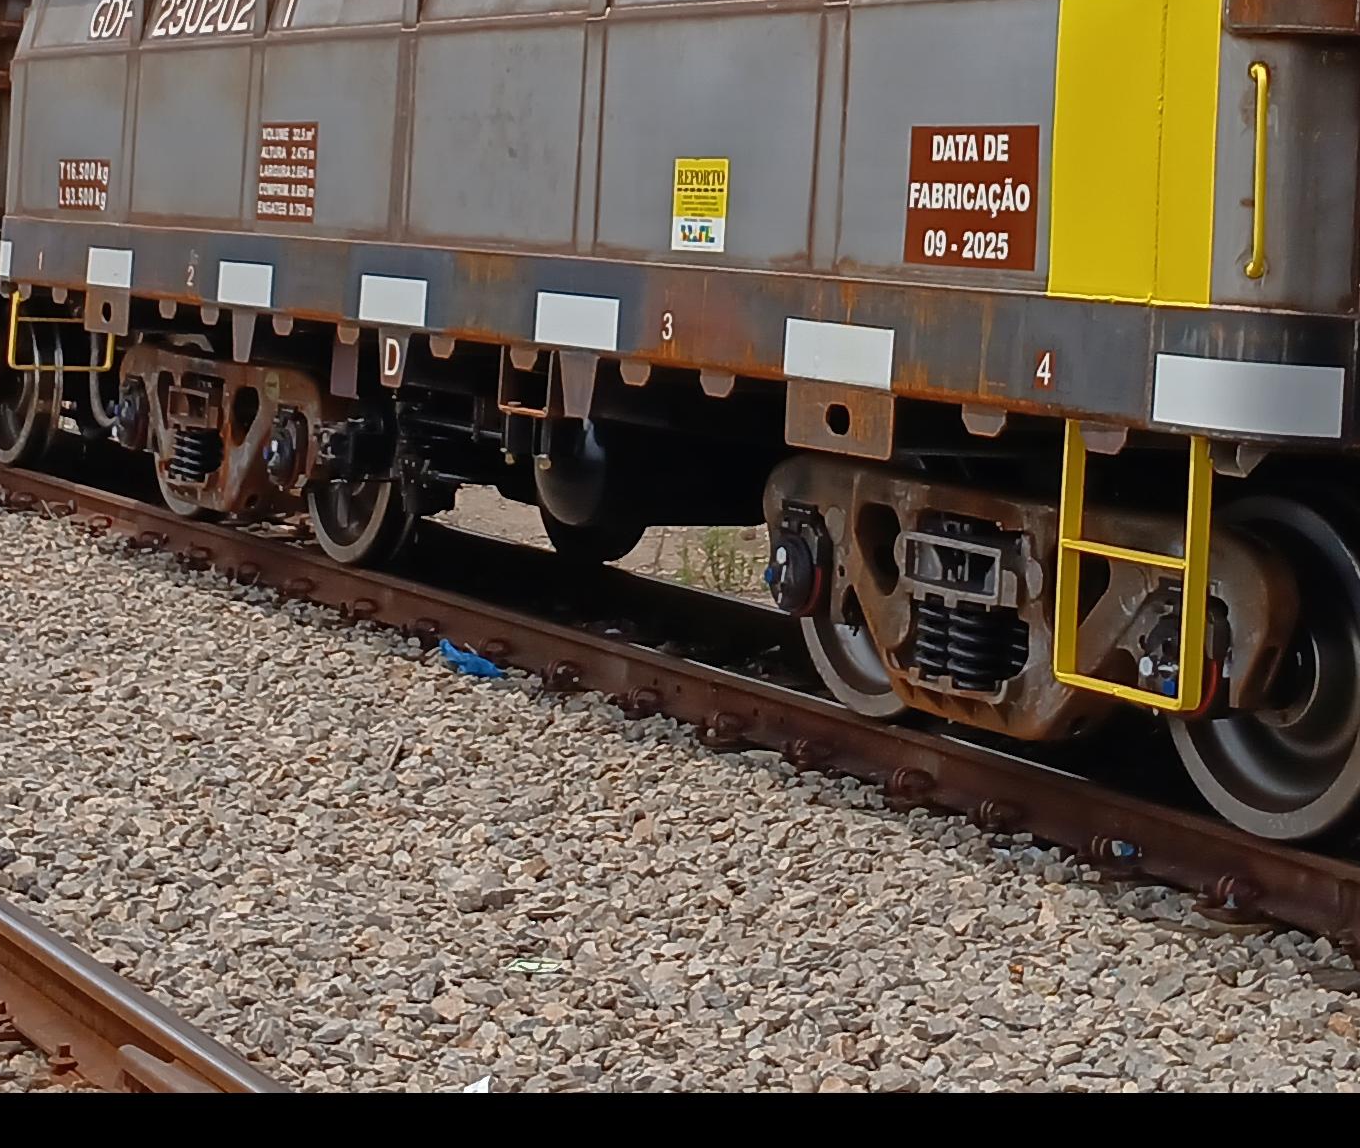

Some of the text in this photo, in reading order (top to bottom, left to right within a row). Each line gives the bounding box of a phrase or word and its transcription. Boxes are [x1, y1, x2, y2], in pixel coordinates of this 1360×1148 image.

[932, 134, 1009, 162] DATA DE
[66, 161, 96, 181] 16.500
[96, 161, 109, 186] kg
[677, 169, 725, 186] REPORTO
[65, 186, 94, 206] 93.500
[94, 187, 107, 211] kg
[908, 177, 1031, 219] FABRICAÇÃO
[923, 229, 947, 257] 09
[962, 230, 1009, 260] 2025
[186, 265, 195, 287] 2
[662, 312, 673, 340] 3
[384, 338, 400, 376] D
[1036, 352, 1051, 386] 4
